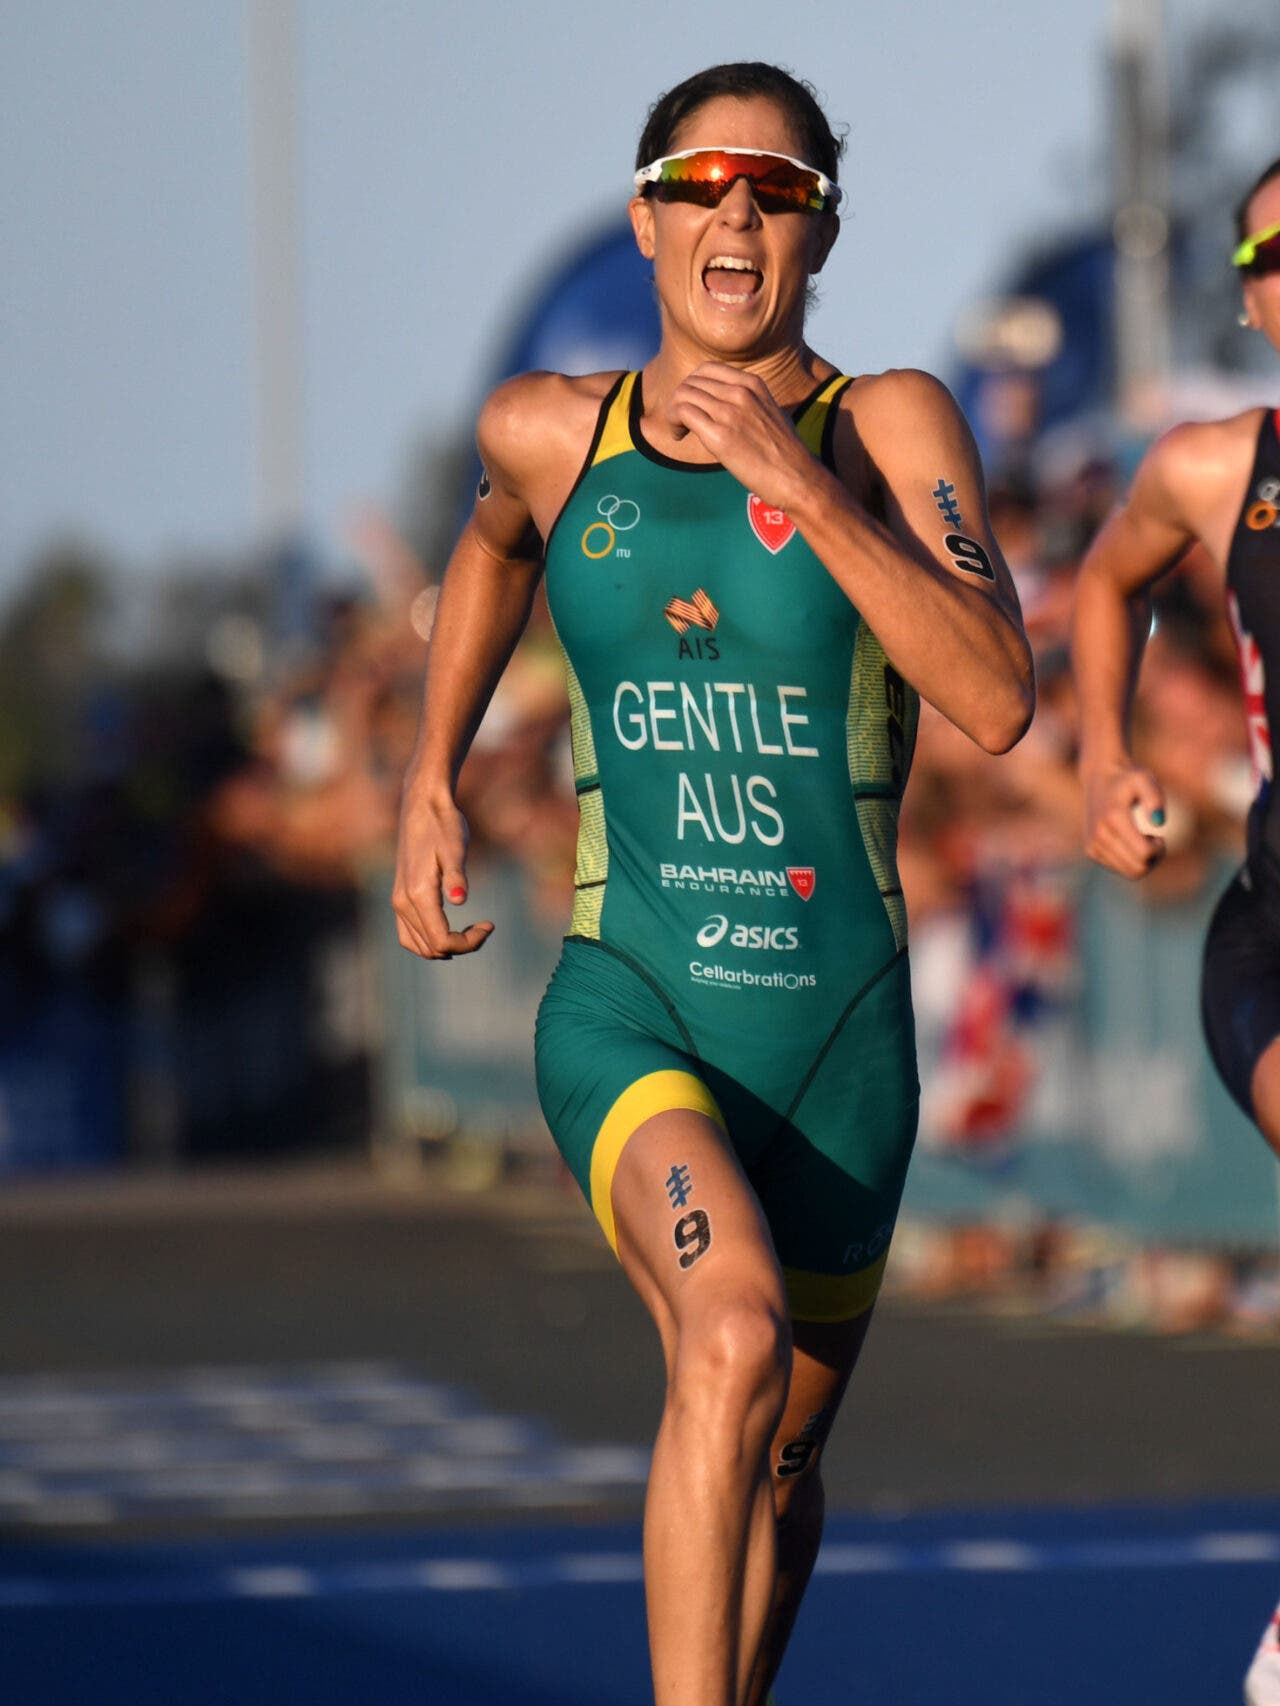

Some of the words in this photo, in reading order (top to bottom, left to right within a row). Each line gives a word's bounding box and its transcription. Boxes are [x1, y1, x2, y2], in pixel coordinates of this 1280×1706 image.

[762, 511, 784, 525] 13
[616, 548, 631, 558] ITU
[944, 534, 995, 582] 9
[678, 637, 721, 661] AIS
[612, 681, 820, 757] GENTLE
[677, 773, 785, 846] AUS
[660, 863, 787, 887] BAHRAIN
[661, 880, 790, 897] ENDURANCE
[730, 923, 799, 951] asics
[689, 961, 817, 989] Cellarbrations
[674, 1209, 712, 1270] 9
[776, 1439, 817, 1478] 9
